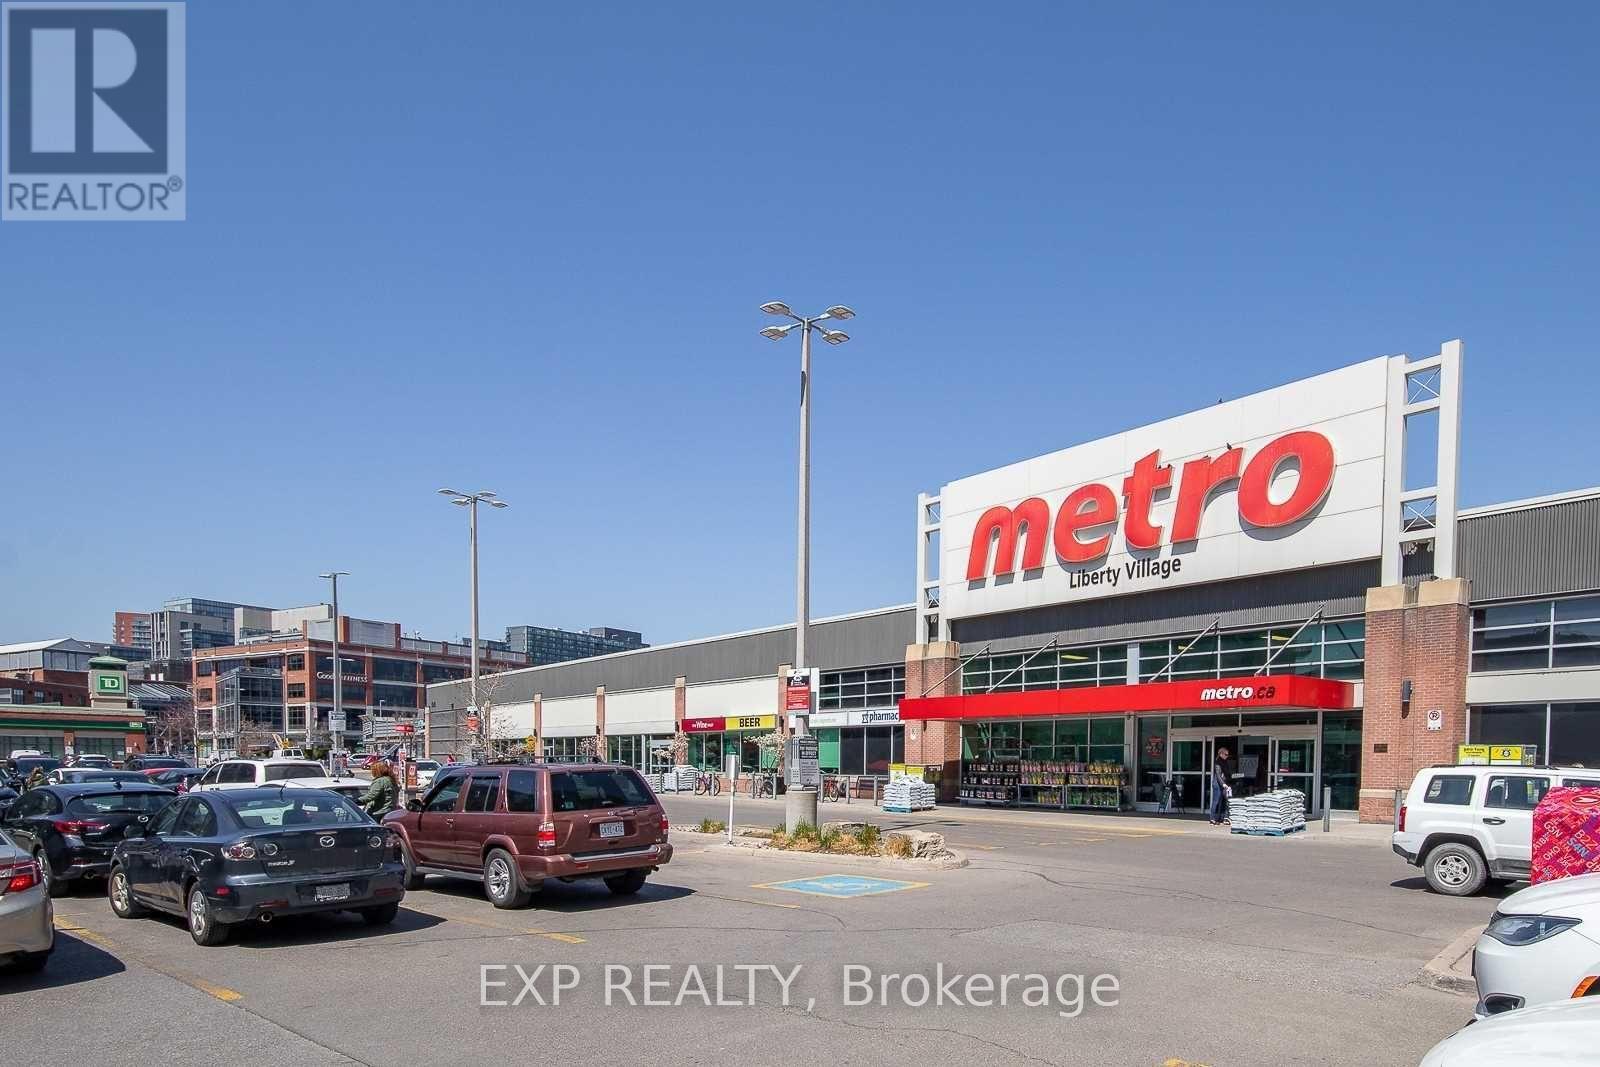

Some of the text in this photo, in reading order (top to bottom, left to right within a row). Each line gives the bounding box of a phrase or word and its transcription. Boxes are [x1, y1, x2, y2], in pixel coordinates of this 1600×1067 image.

[965, 430, 1337, 582] metro
[1069, 557, 1182, 589] Liberty Village
[100, 677, 119, 688] TD
[1200, 685, 1276, 701] metro.ca
[739, 717, 761, 728] BEER
[869, 711, 899, 724] pharmac
